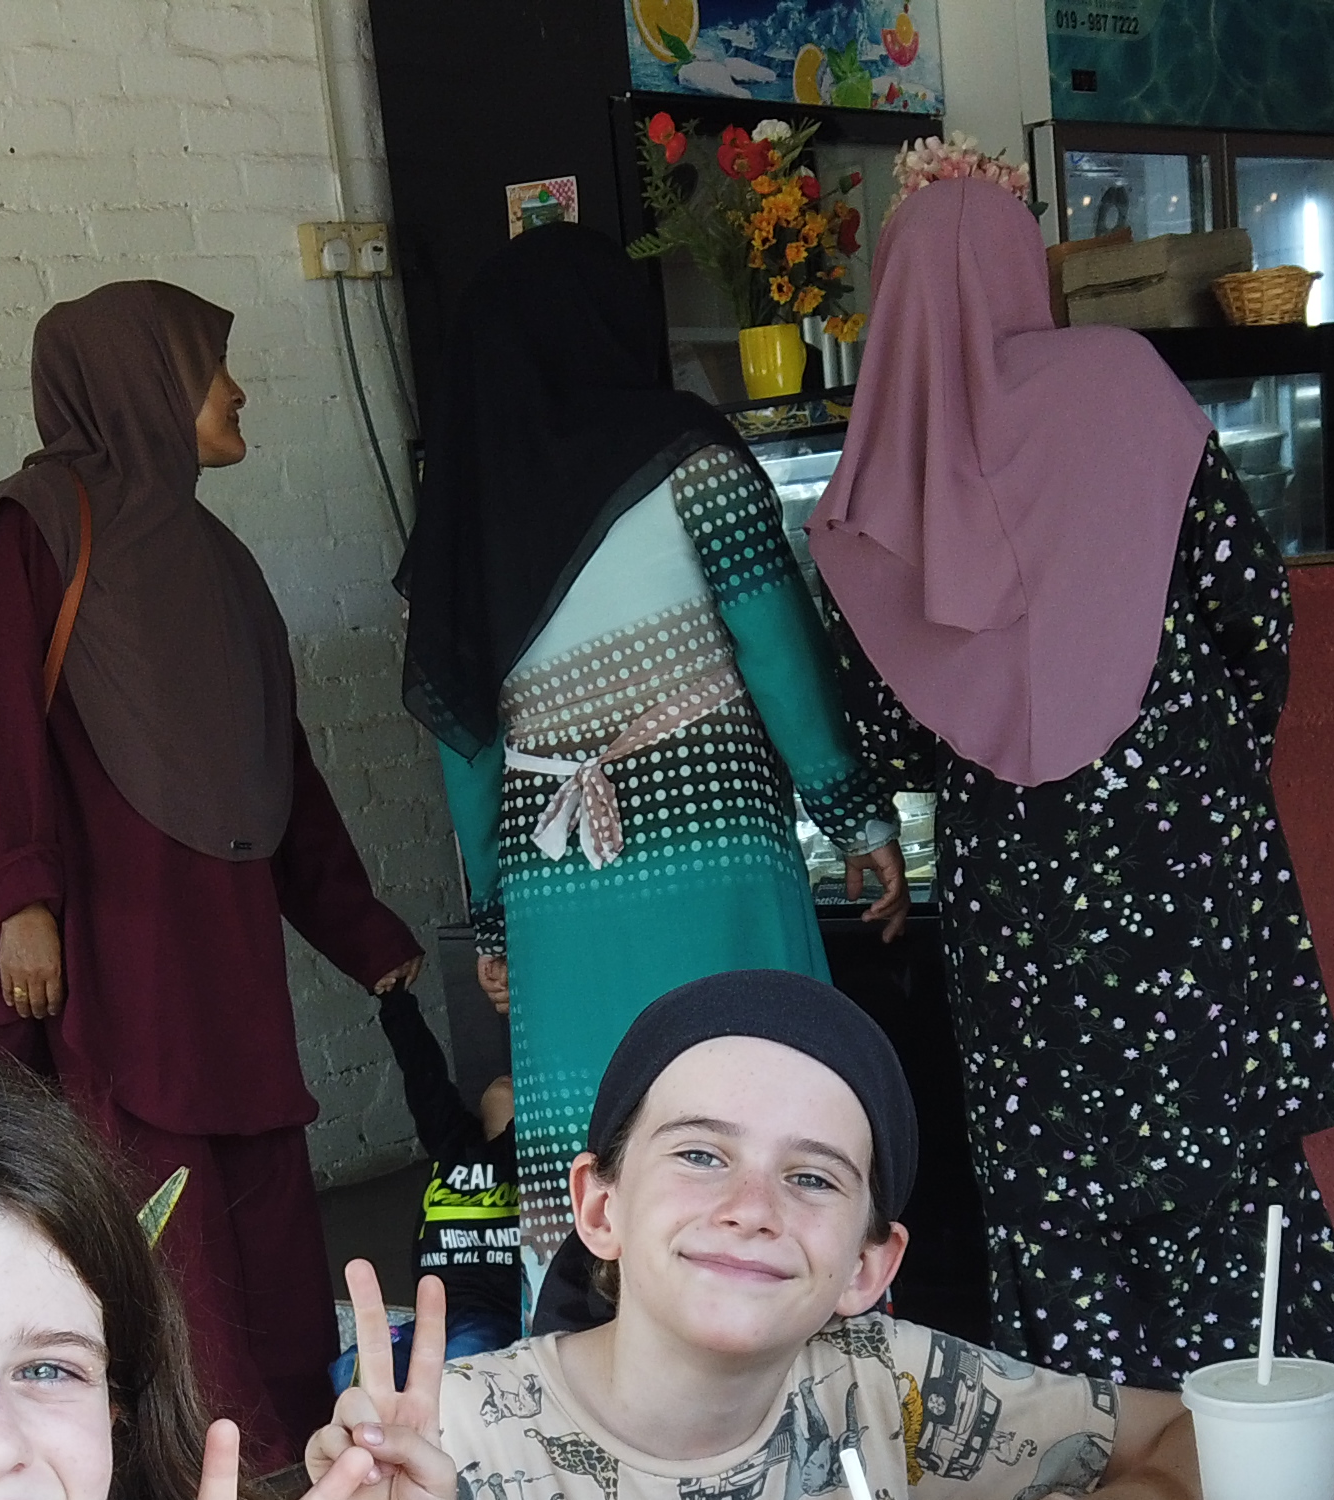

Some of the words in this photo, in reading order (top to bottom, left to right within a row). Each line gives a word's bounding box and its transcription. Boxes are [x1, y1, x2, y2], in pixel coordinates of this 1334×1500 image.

[1055, 10, 1077, 29] 019
[1088, 13, 1109, 32] 987
[486, 1250, 514, 1265] ORG
